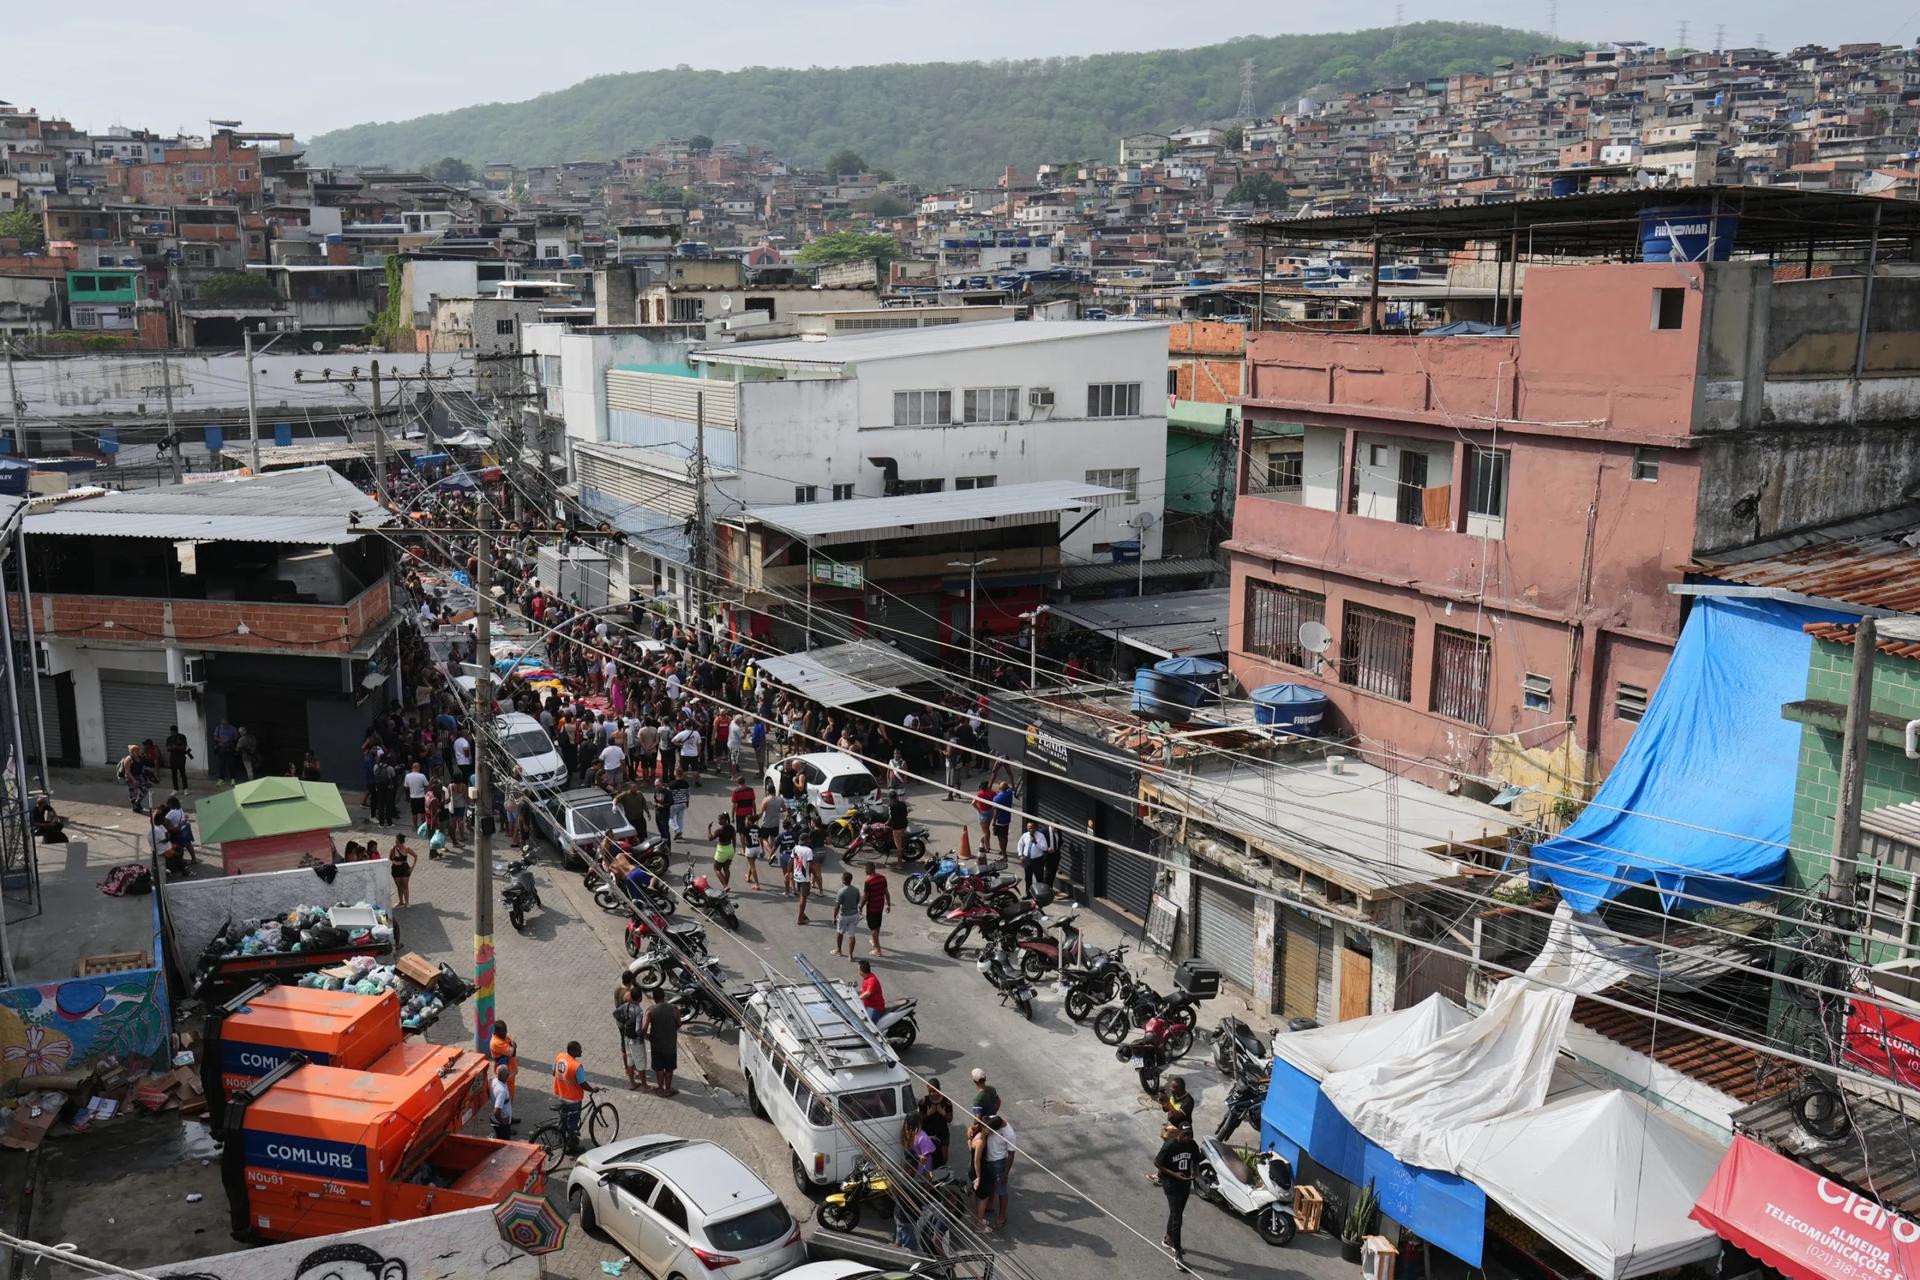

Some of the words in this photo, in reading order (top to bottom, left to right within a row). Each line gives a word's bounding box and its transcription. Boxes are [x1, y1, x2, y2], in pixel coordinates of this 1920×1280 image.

[267, 1144, 352, 1168] COMLURB
[1817, 1176, 1920, 1243] Claro
[1765, 1203, 1893, 1278] TELECOMUNICAÇÕES
[1806, 1243, 1833, 1265] (021)
[1830, 1225, 1890, 1264] ALMEIDA
